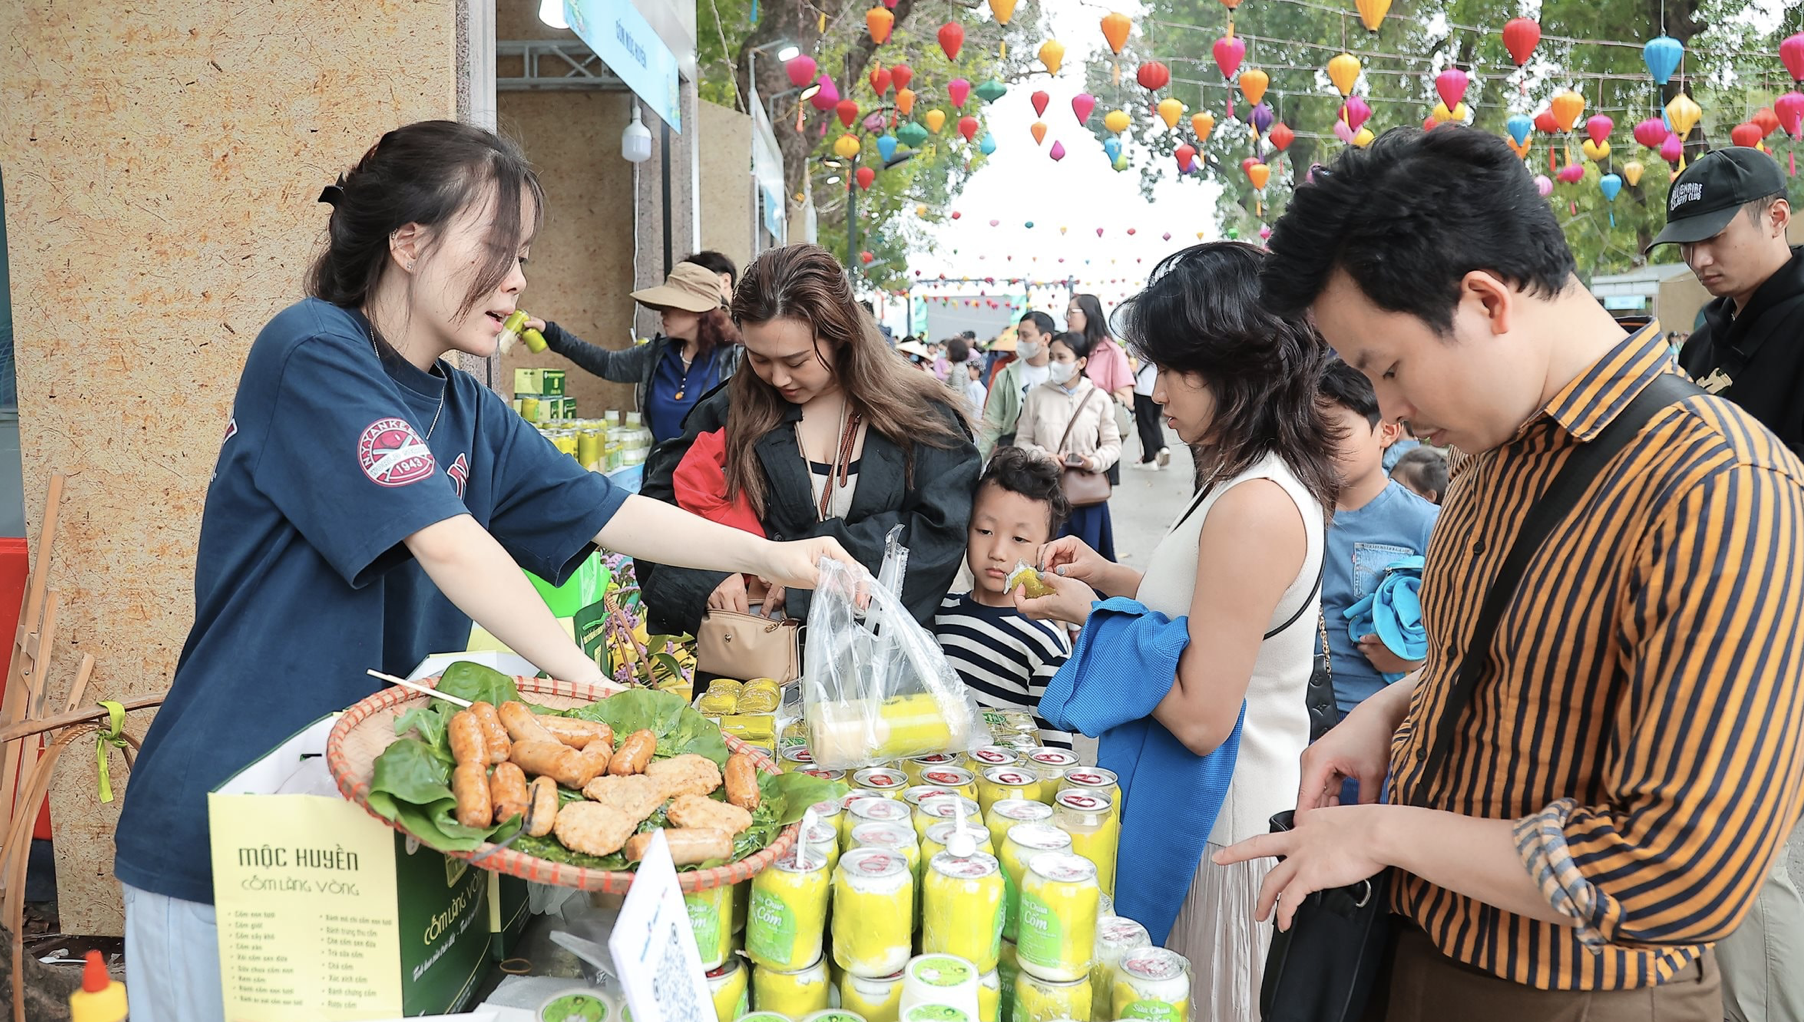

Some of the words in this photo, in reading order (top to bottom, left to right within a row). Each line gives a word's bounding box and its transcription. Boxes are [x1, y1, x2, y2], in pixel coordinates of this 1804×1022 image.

[396, 458, 423, 474] 1943
[239, 844, 287, 869] MỘC
[296, 843, 359, 871] HUYỀN
[241, 874, 277, 891] CỐM
[279, 876, 312, 892] LÀNG
[315, 879, 360, 896] VÒNG
[424, 914, 448, 945] CỐM
[448, 892, 467, 924] LÀNG
[757, 906, 783, 927] Cốm
[1025, 910, 1049, 930] Cốm
[1133, 1003, 1148, 1014] Sữa
